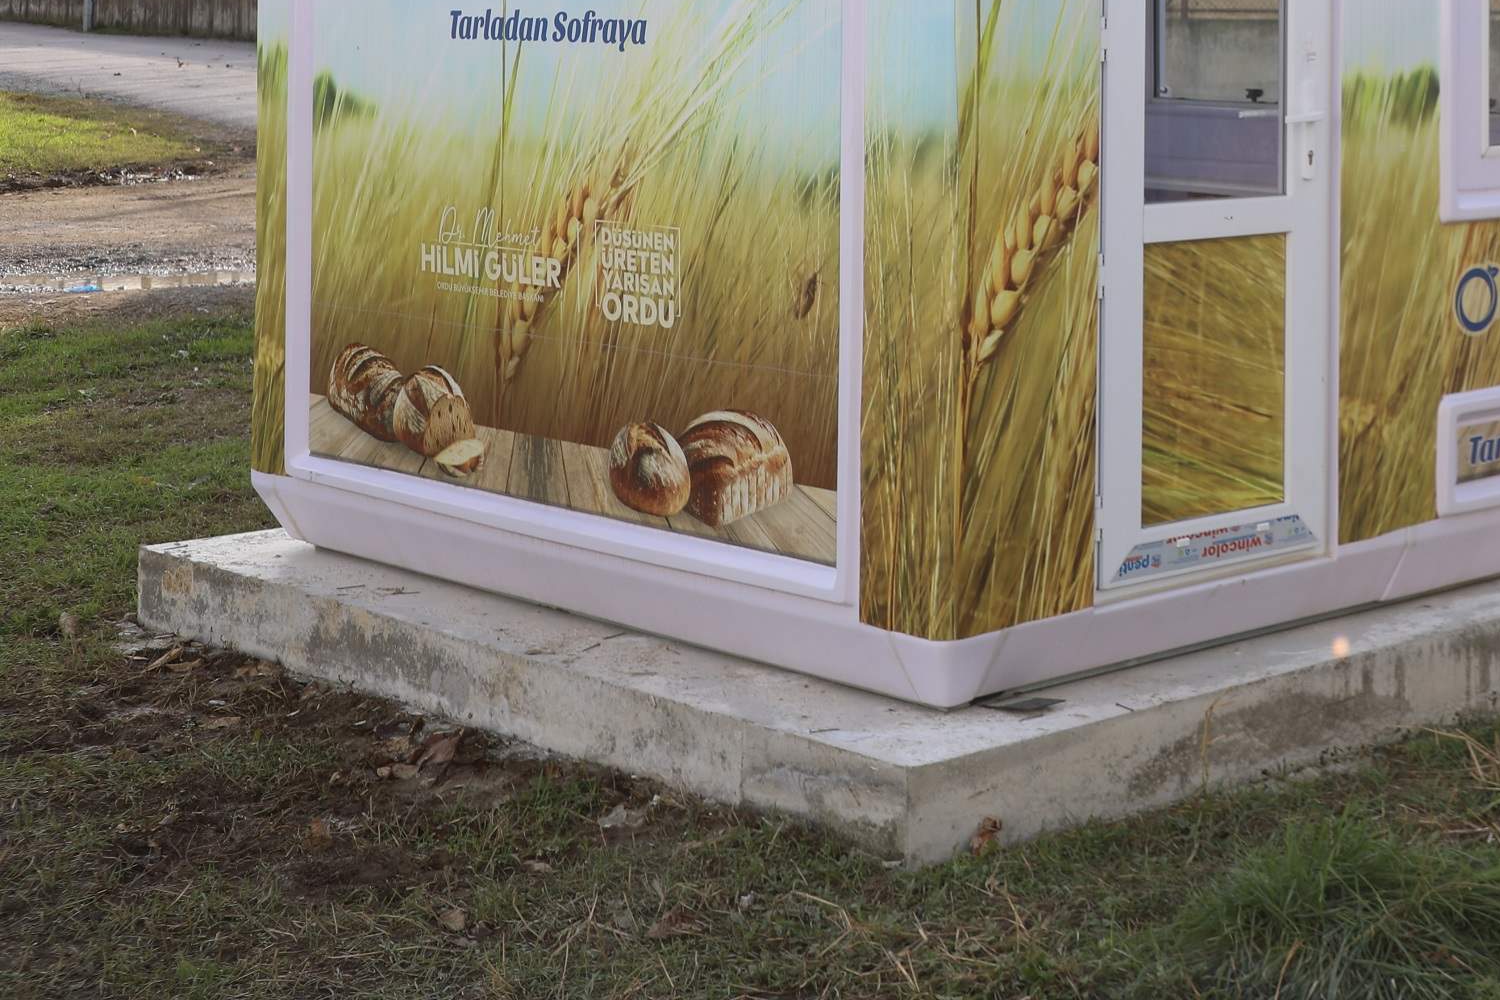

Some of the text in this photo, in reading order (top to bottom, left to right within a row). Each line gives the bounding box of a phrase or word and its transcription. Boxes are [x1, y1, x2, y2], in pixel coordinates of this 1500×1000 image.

[450, 8, 647, 52] Tarladan Sofraya
[473, 206, 540, 248] Mehmet
[485, 251, 561, 289] GÜLER
[601, 248, 674, 275] ÜRETEN
[602, 292, 675, 328] ORDU
[1201, 536, 1262, 558] wincolor
